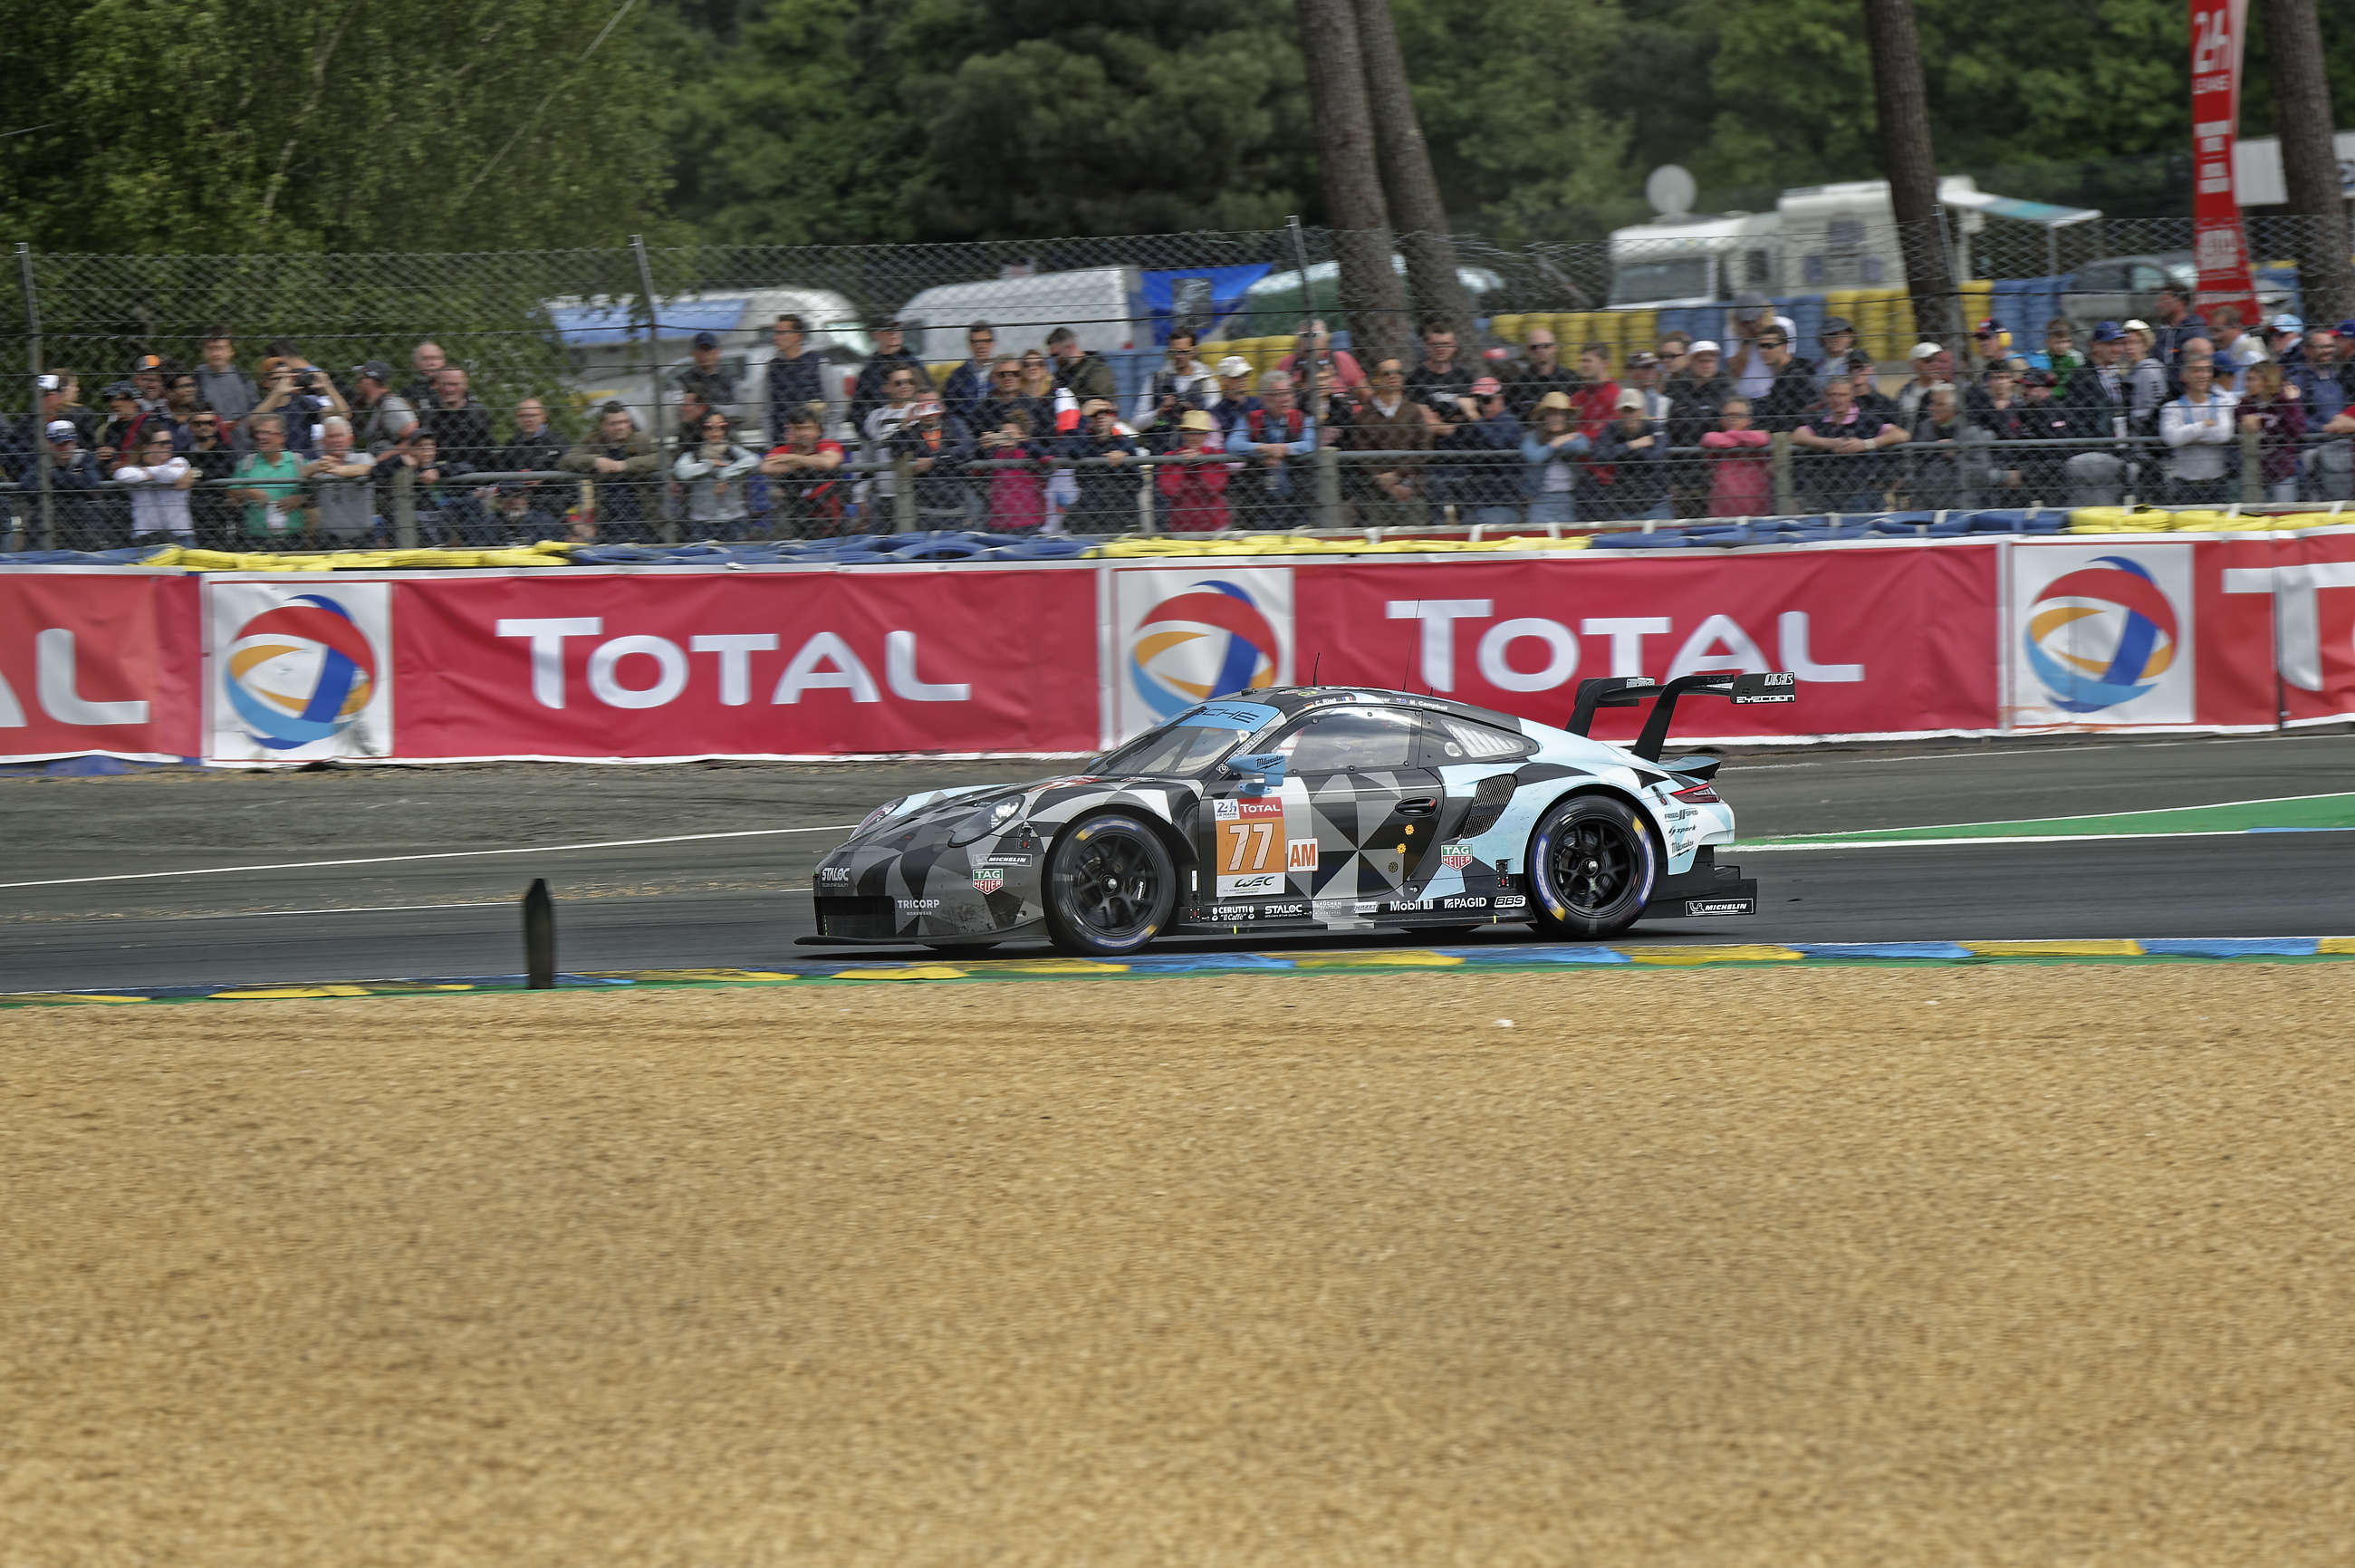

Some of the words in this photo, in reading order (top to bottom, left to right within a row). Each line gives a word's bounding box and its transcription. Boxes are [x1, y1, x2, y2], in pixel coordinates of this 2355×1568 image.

[1386, 599, 1864, 693] TOTAL
[495, 617, 972, 709] TOTAL
[1240, 804, 1281, 813] TOTAL
[1228, 822, 1274, 871] 77
[1444, 846, 1469, 855] TAG
[1290, 843, 1316, 868] AM
[1443, 856, 1471, 868] HEUER
[822, 867, 851, 881] STALOC
[976, 871, 1001, 879] TAG
[974, 880, 1002, 892] HEUER
[1235, 876, 1275, 888] WEC
[897, 899, 940, 909] TRICORP
[1389, 899, 1421, 912] Mobil
[1454, 897, 1487, 909] PAGID
[1495, 896, 1525, 908] BBS
[1705, 903, 1747, 911] MICHELIN
[1218, 905, 1248, 914] CERUTTI
[1264, 904, 1302, 915] STALOC
